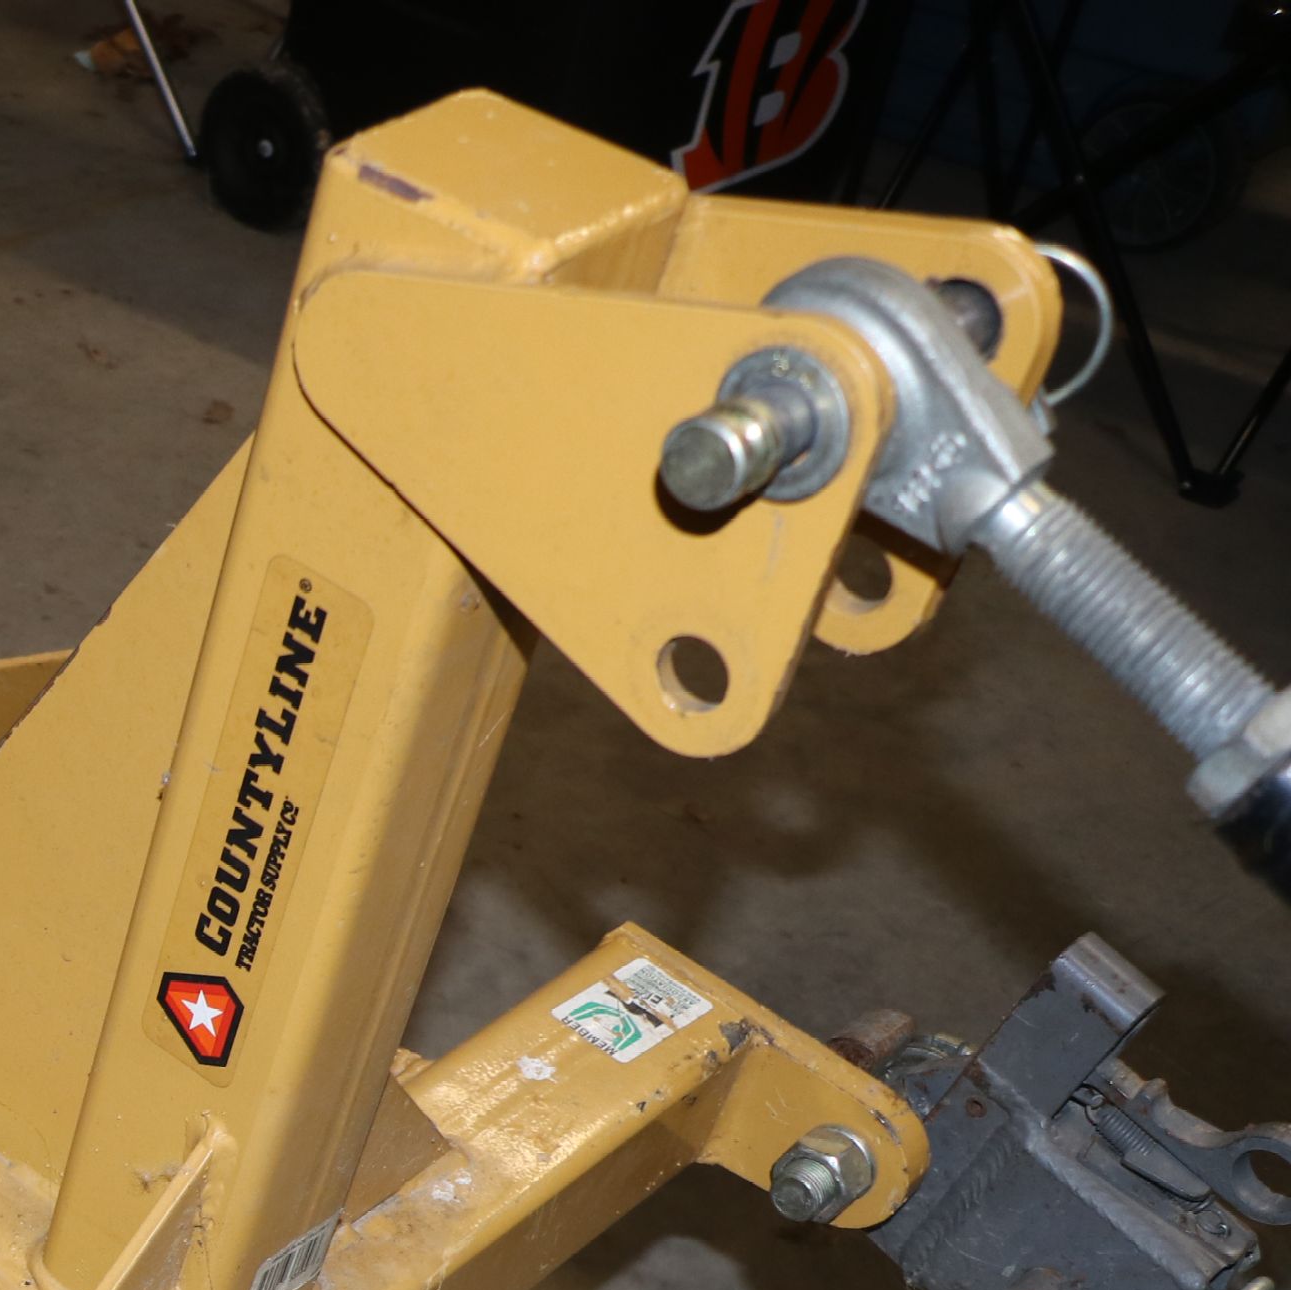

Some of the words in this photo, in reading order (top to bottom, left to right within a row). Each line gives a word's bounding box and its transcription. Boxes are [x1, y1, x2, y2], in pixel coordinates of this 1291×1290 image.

[235, 888, 273, 972] TRACTOR
[260, 820, 292, 891] SUPPLY
[560, 1016, 619, 1057] MEMBER
